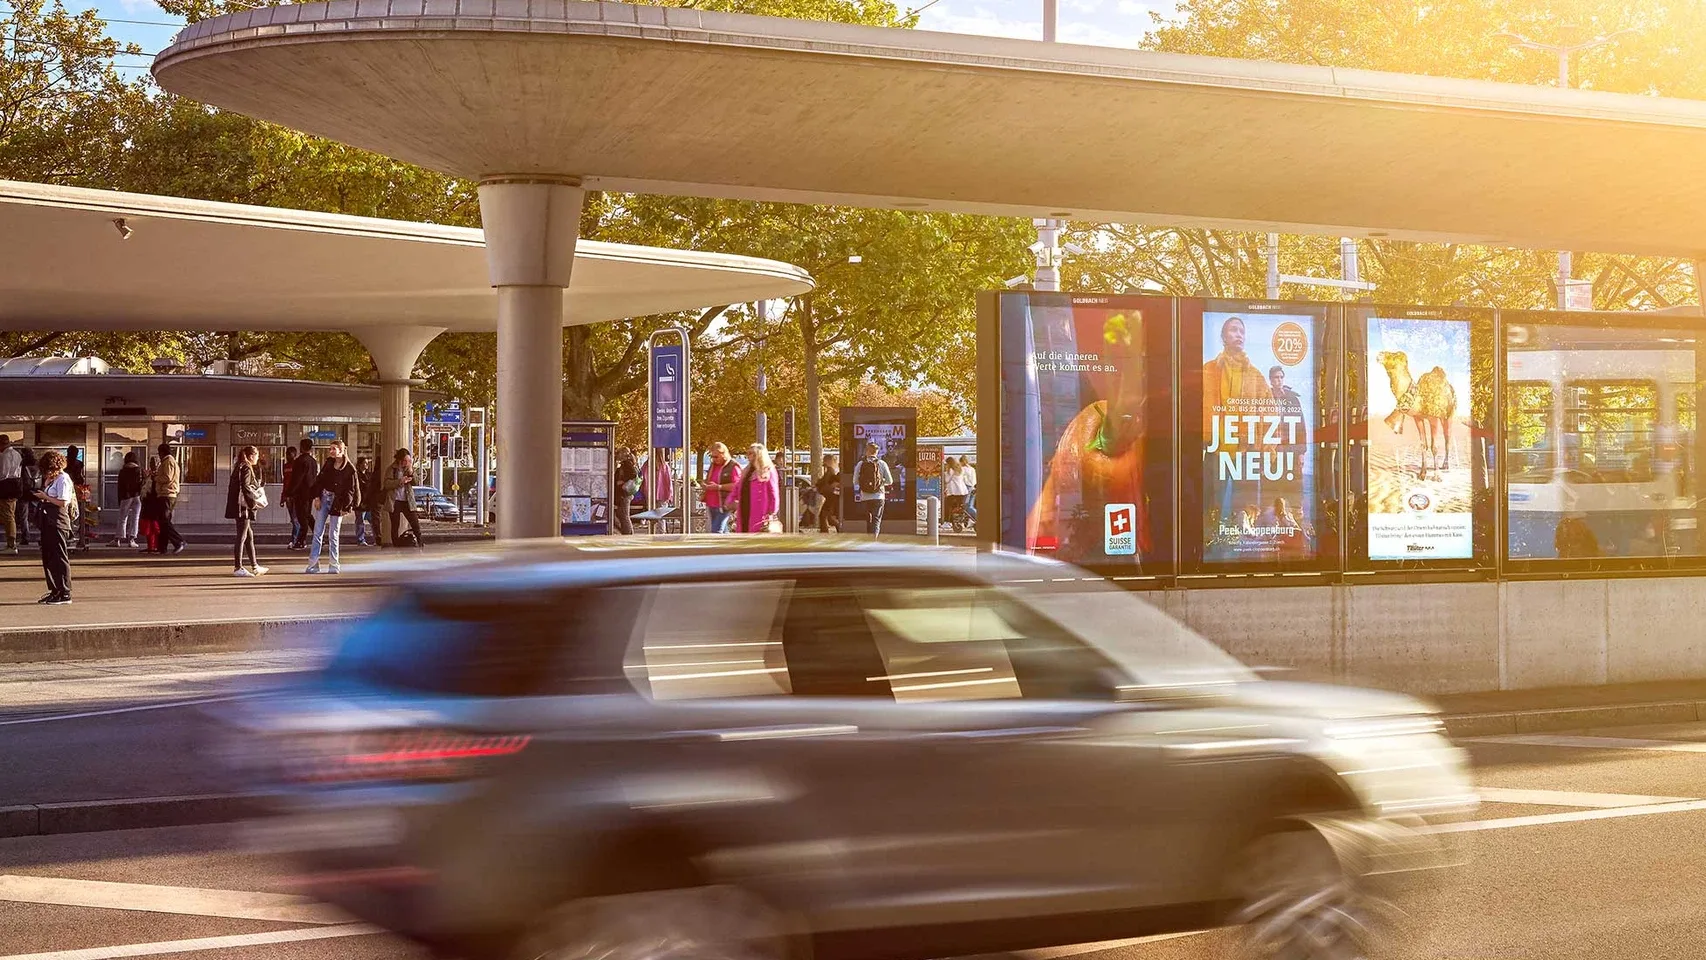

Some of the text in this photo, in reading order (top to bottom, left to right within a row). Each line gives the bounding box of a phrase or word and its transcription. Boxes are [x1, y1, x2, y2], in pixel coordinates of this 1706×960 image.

[1278, 338, 1302, 352] 20%
[1031, 351, 1098, 361] Auf die inneren
[1059, 362, 1090, 372] kommt
[1093, 364, 1102, 372] es
[1251, 397, 1287, 406] ERÖFFNUNG
[1207, 415, 1301, 453] JETZT
[918, 452, 936, 461] LUZIA
[1219, 452, 1294, 481] NEU!
[1109, 537, 1131, 545] SUISSE
